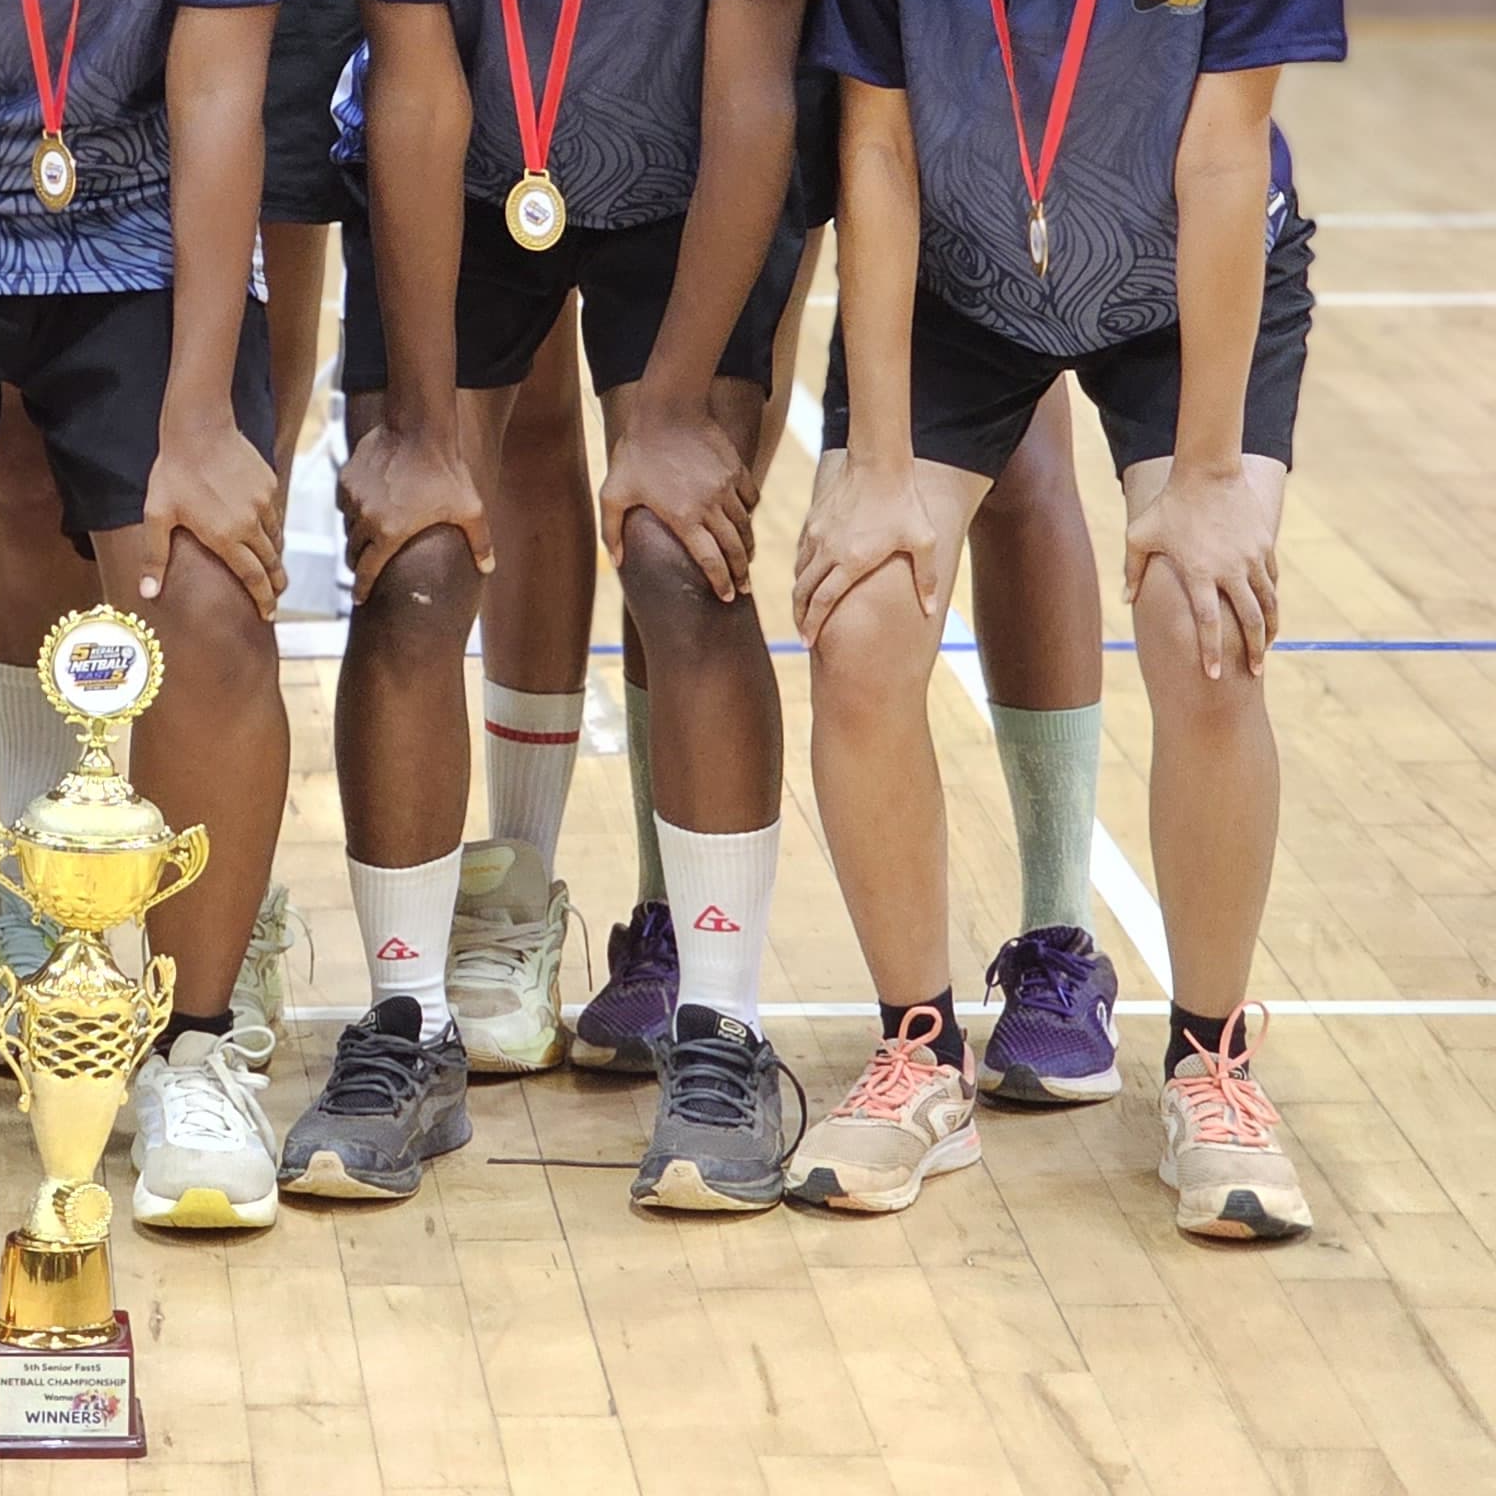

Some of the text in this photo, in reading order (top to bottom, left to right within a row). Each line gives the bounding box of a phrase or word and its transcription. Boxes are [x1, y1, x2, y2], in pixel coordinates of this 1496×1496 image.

[23, 1364, 40, 1372] 5th
[41, 1363, 72, 1372] Senior
[0, 1378, 126, 1387] NETBALL CHAMPIONSHIP
[25, 1411, 102, 1424] WINNERS
